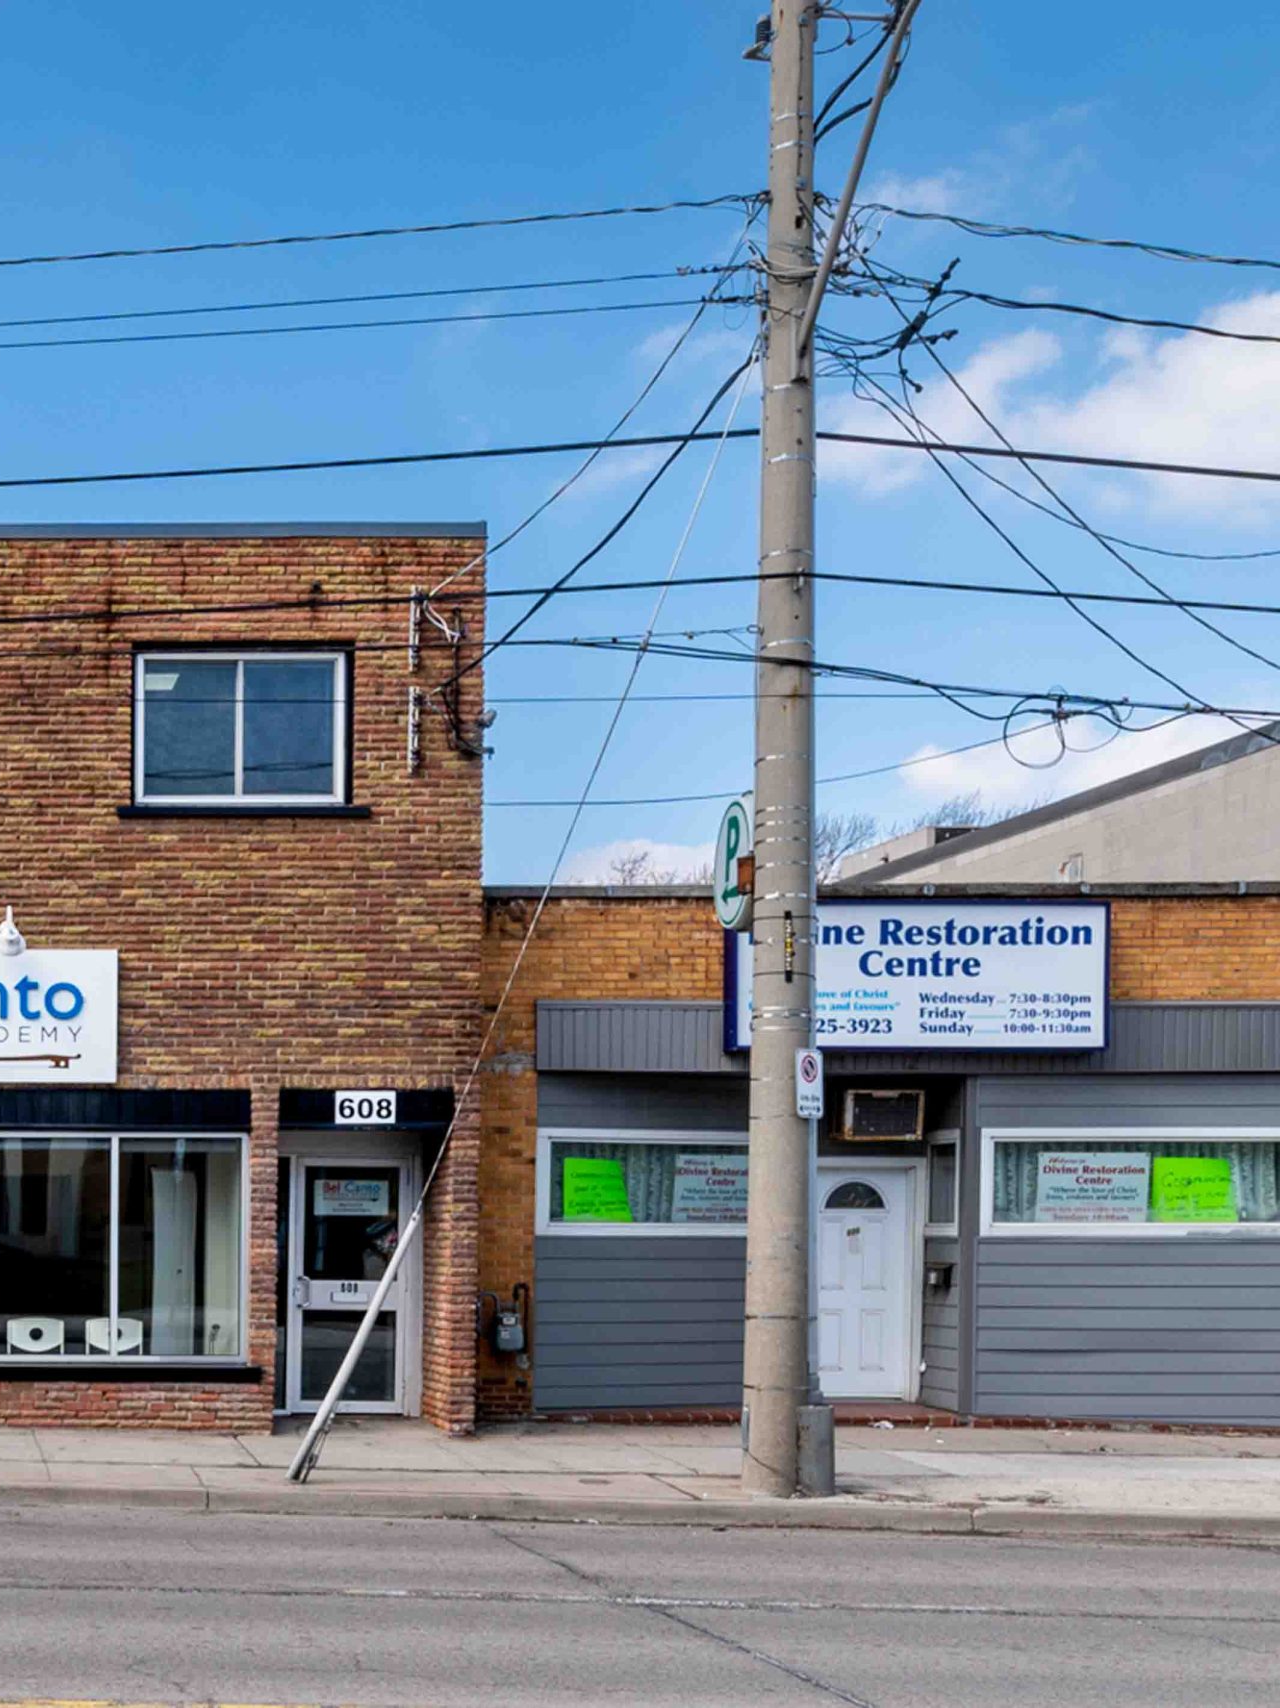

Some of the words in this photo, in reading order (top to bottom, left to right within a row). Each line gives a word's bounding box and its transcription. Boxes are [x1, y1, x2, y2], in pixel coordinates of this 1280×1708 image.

[879, 917, 1093, 946] Restoration
[858, 949, 981, 977] Centre
[919, 992, 995, 1006] Wednesday
[1009, 993, 1092, 1005] 7:30-8:30pm
[919, 1007, 966, 1021] Friday
[1009, 1008, 1092, 1021] 7:30-9:30pm
[816, 1018, 893, 1034] 25-3923
[919, 1022, 974, 1036] Sunday
[1003, 1023, 1092, 1034] 10:00-11:30am
[338, 1098, 392, 1119] 608
[1043, 1165, 1079, 1174] Divine
[1082, 1165, 1145, 1174] Restoration
[1075, 1176, 1112, 1185] Centre
